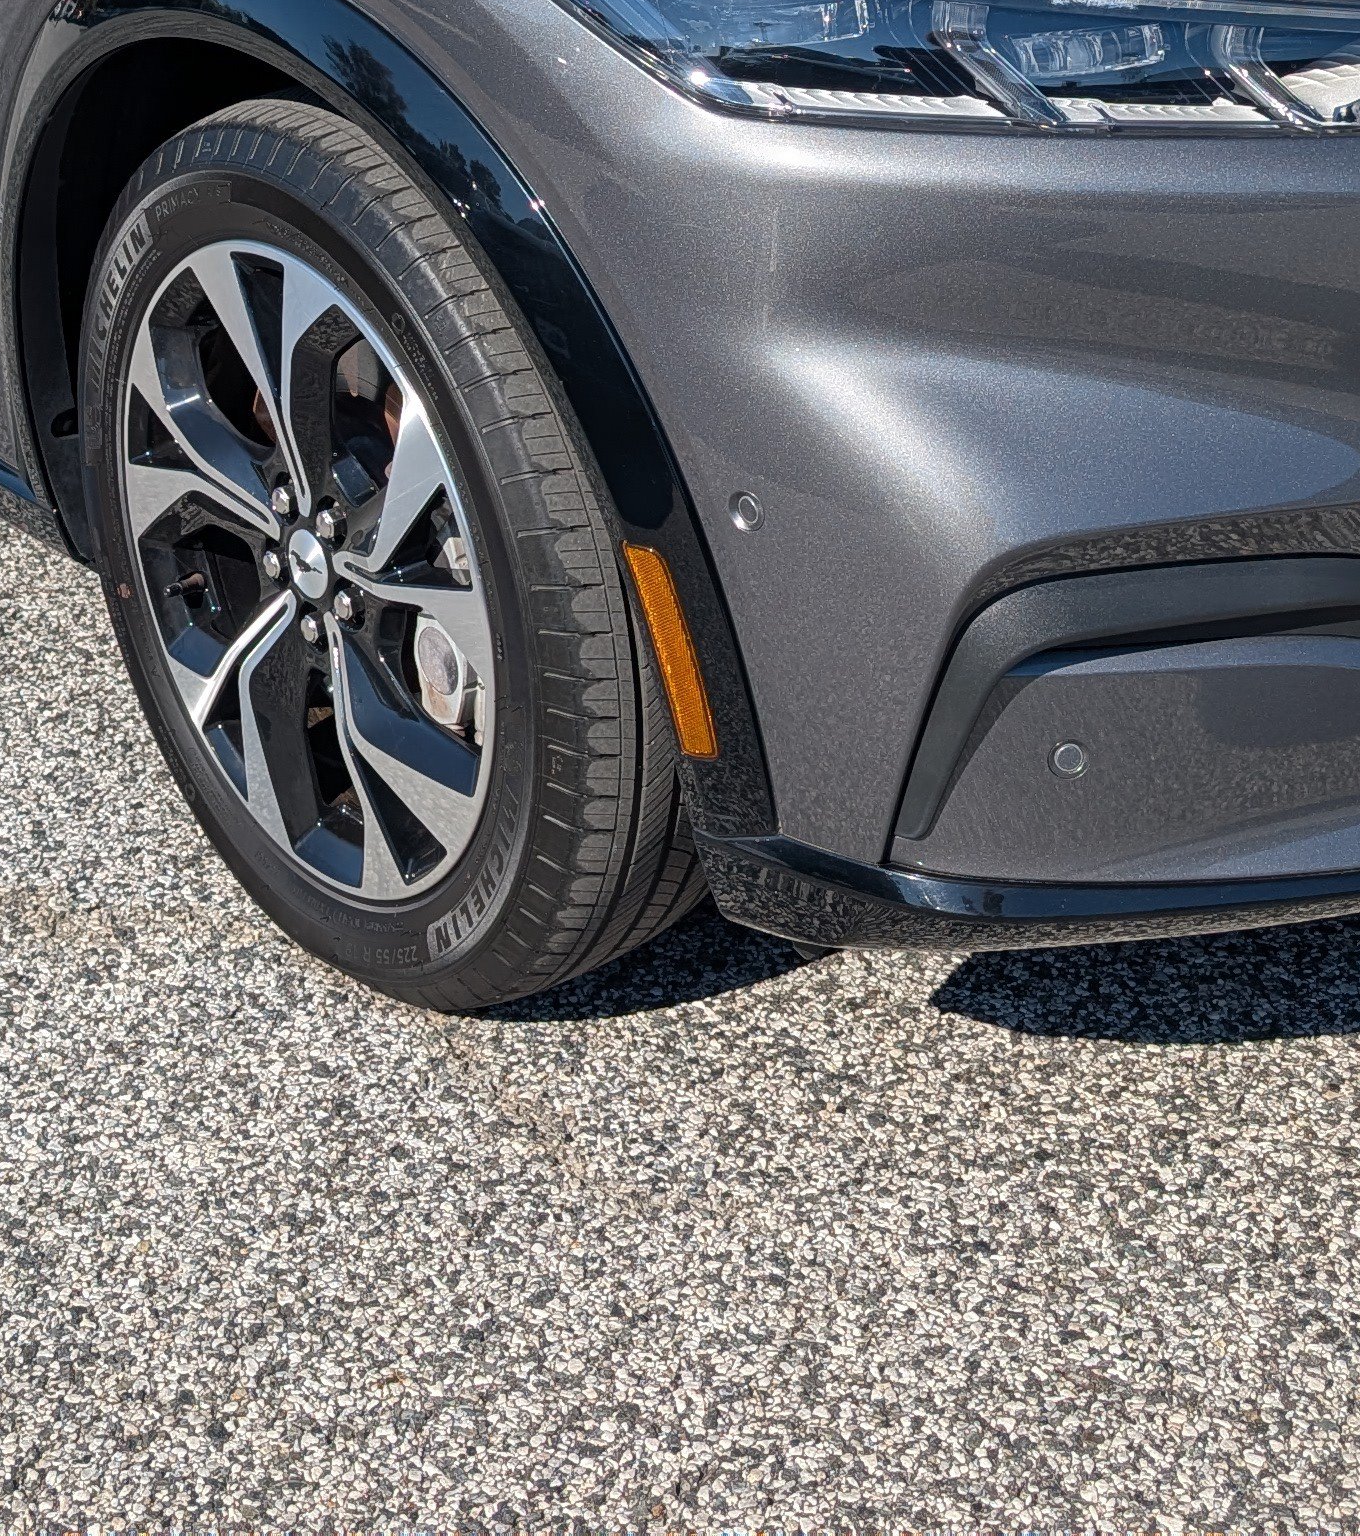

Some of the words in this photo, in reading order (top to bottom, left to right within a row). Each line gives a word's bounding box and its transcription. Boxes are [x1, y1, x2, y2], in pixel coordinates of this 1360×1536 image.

[155, 187, 199, 221] PRIMACY
[90, 221, 149, 388] MICHELIN
[433, 782, 520, 954] MICHELIN
[376, 945, 418, 965] 225/55
